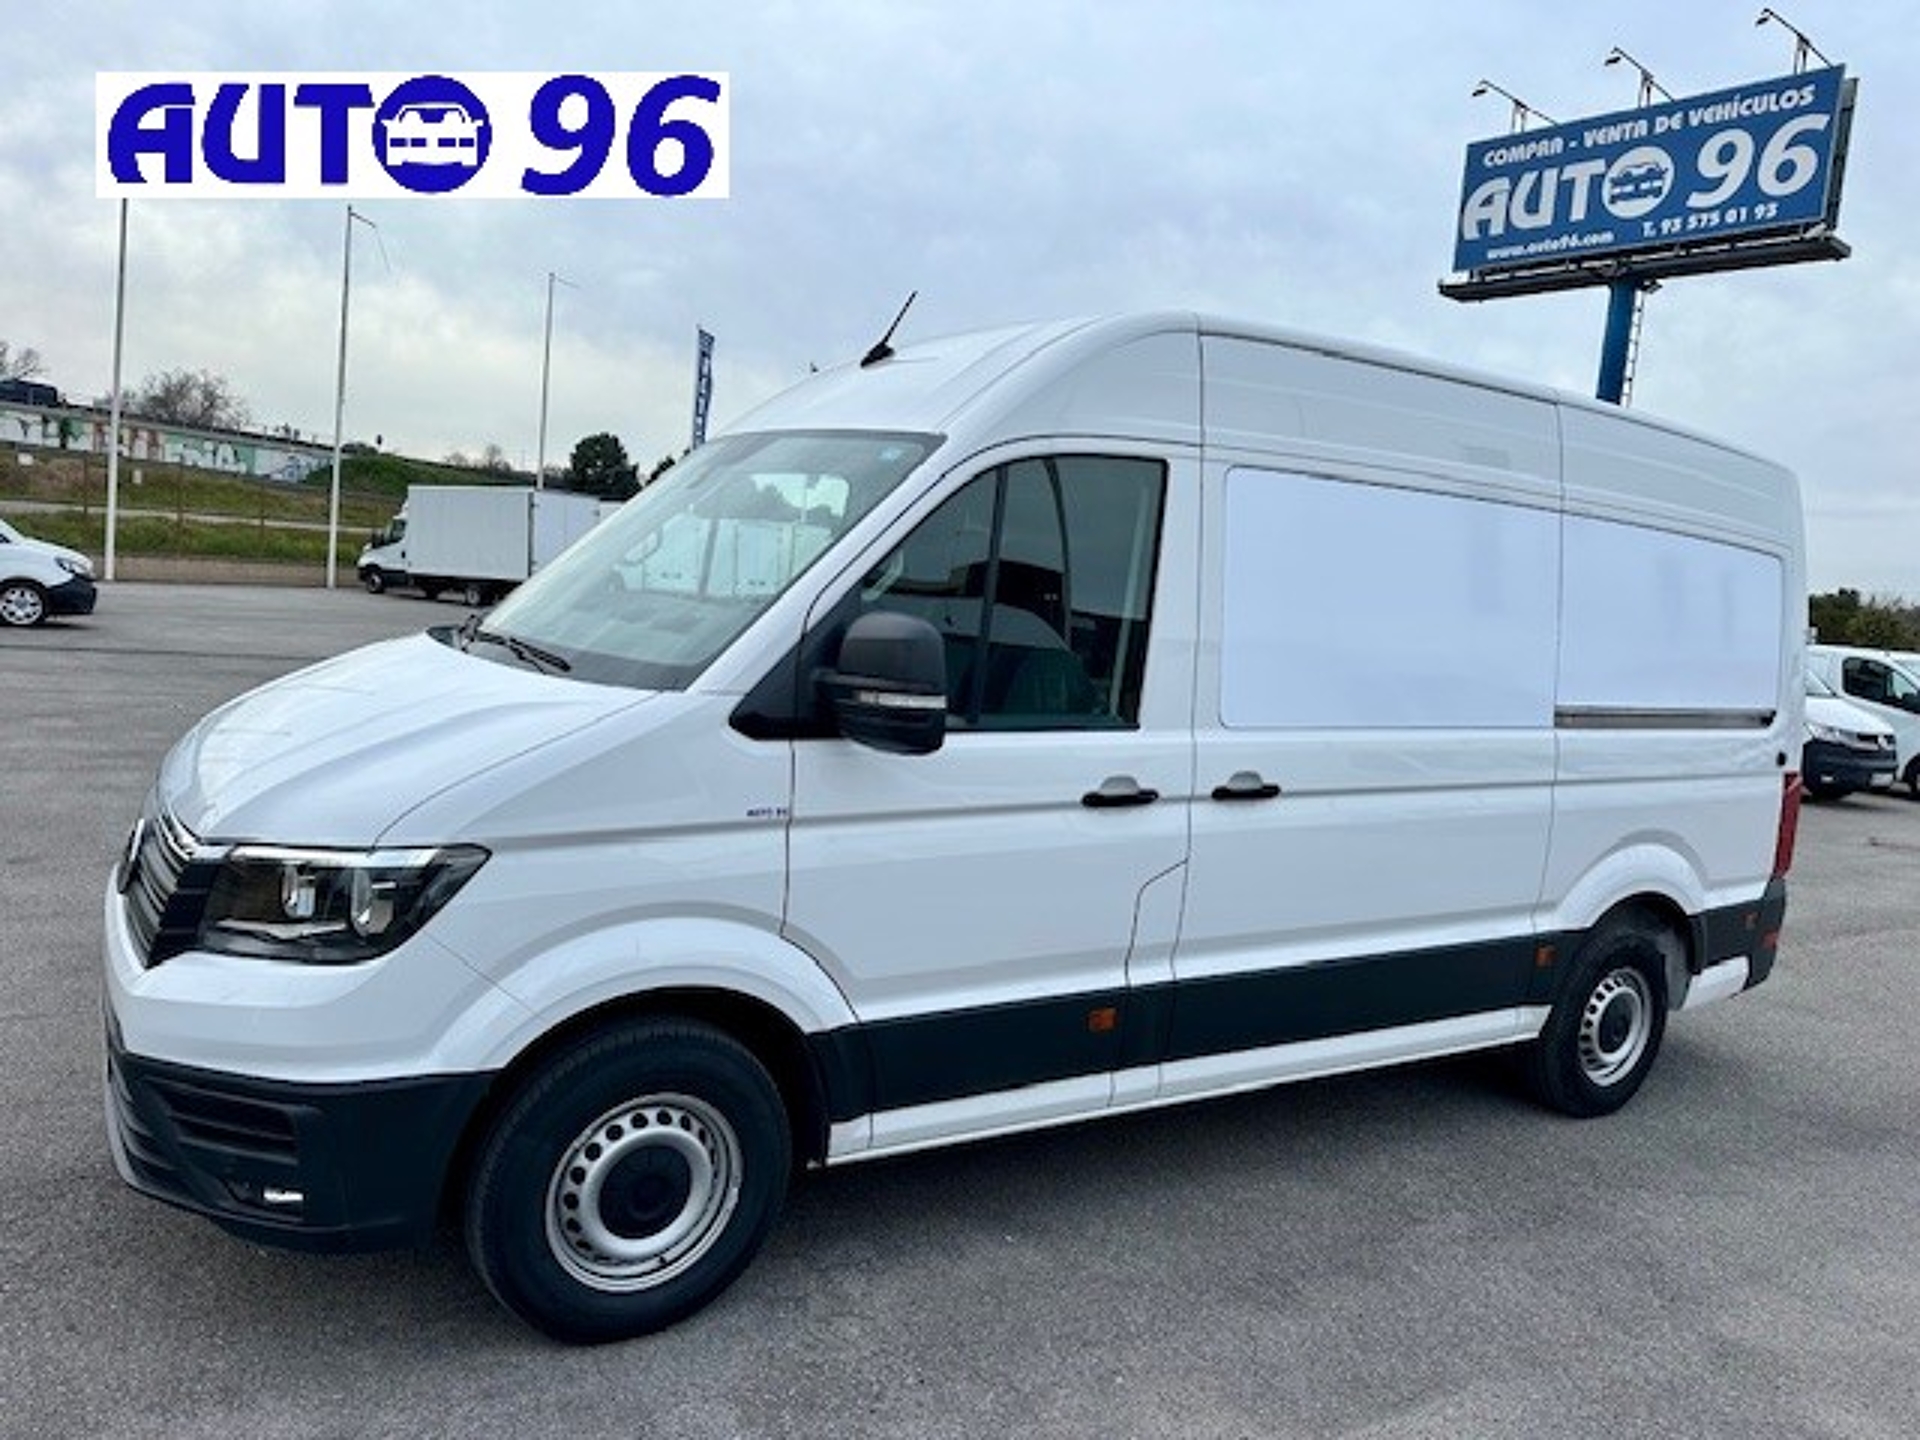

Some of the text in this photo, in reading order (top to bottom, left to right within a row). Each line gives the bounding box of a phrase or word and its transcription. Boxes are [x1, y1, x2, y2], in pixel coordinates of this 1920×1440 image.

[1582, 119, 1648, 148] VENTA
[1654, 111, 1684, 135] DE
[1688, 83, 1816, 127] VEHÍCULOS
[1461, 113, 1831, 242] AUTO 96
[1724, 207, 1747, 223] 01
